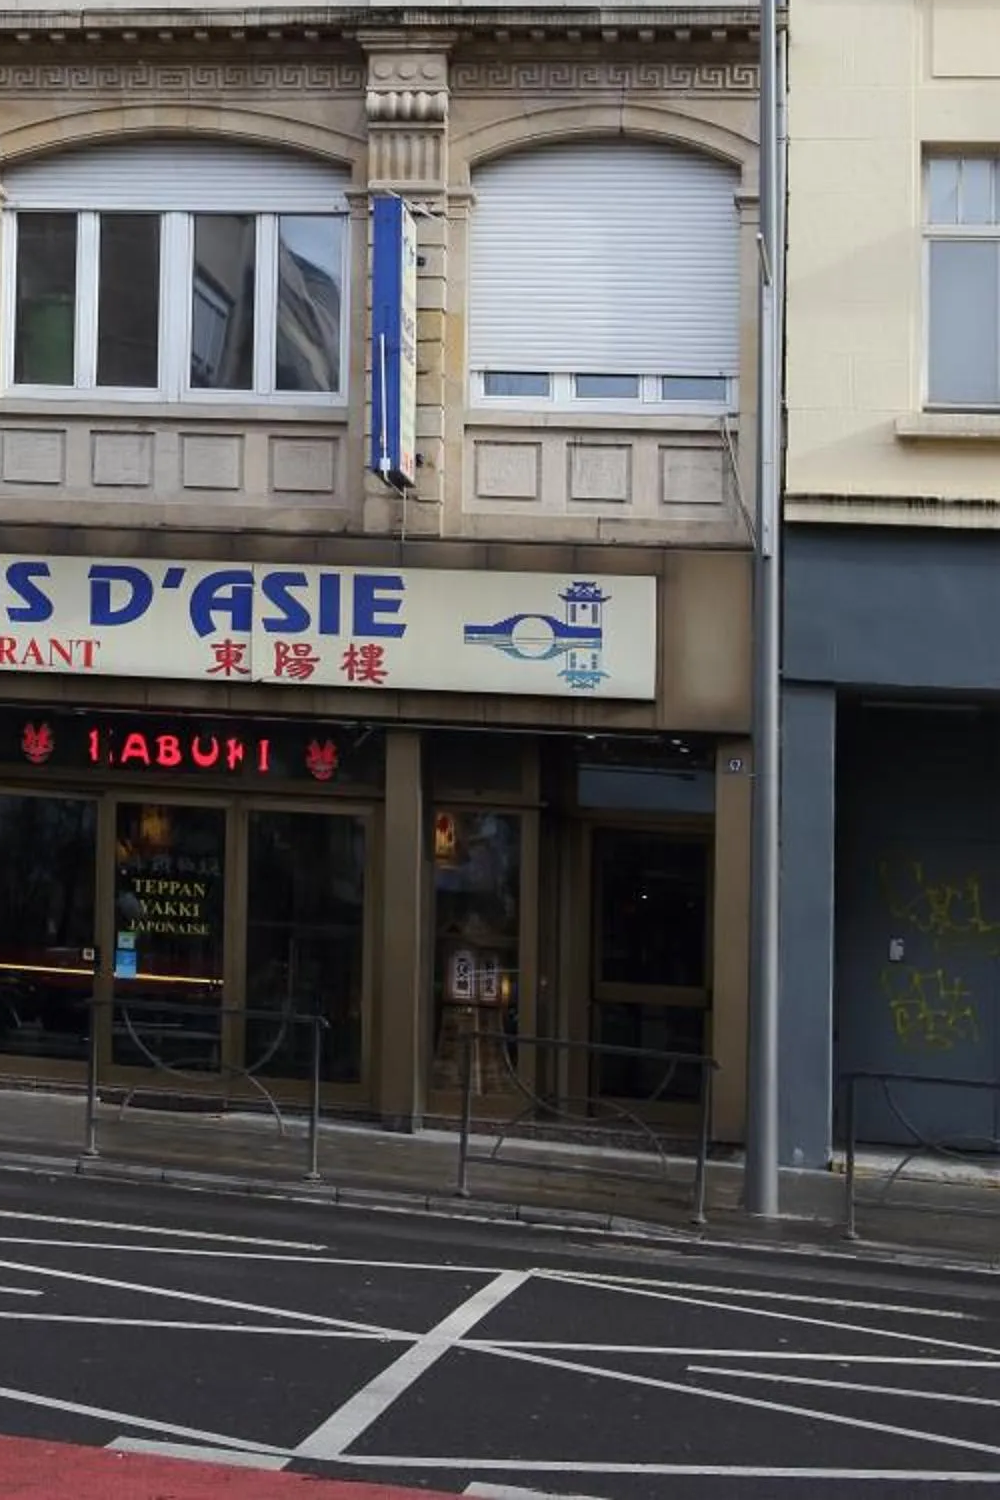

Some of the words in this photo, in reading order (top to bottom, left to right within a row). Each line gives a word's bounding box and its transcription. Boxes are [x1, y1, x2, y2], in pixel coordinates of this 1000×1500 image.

[88, 564, 407, 638] D'ASIE
[132, 878, 206, 899] TEPPAN
[140, 899, 200, 917] YAKKI
